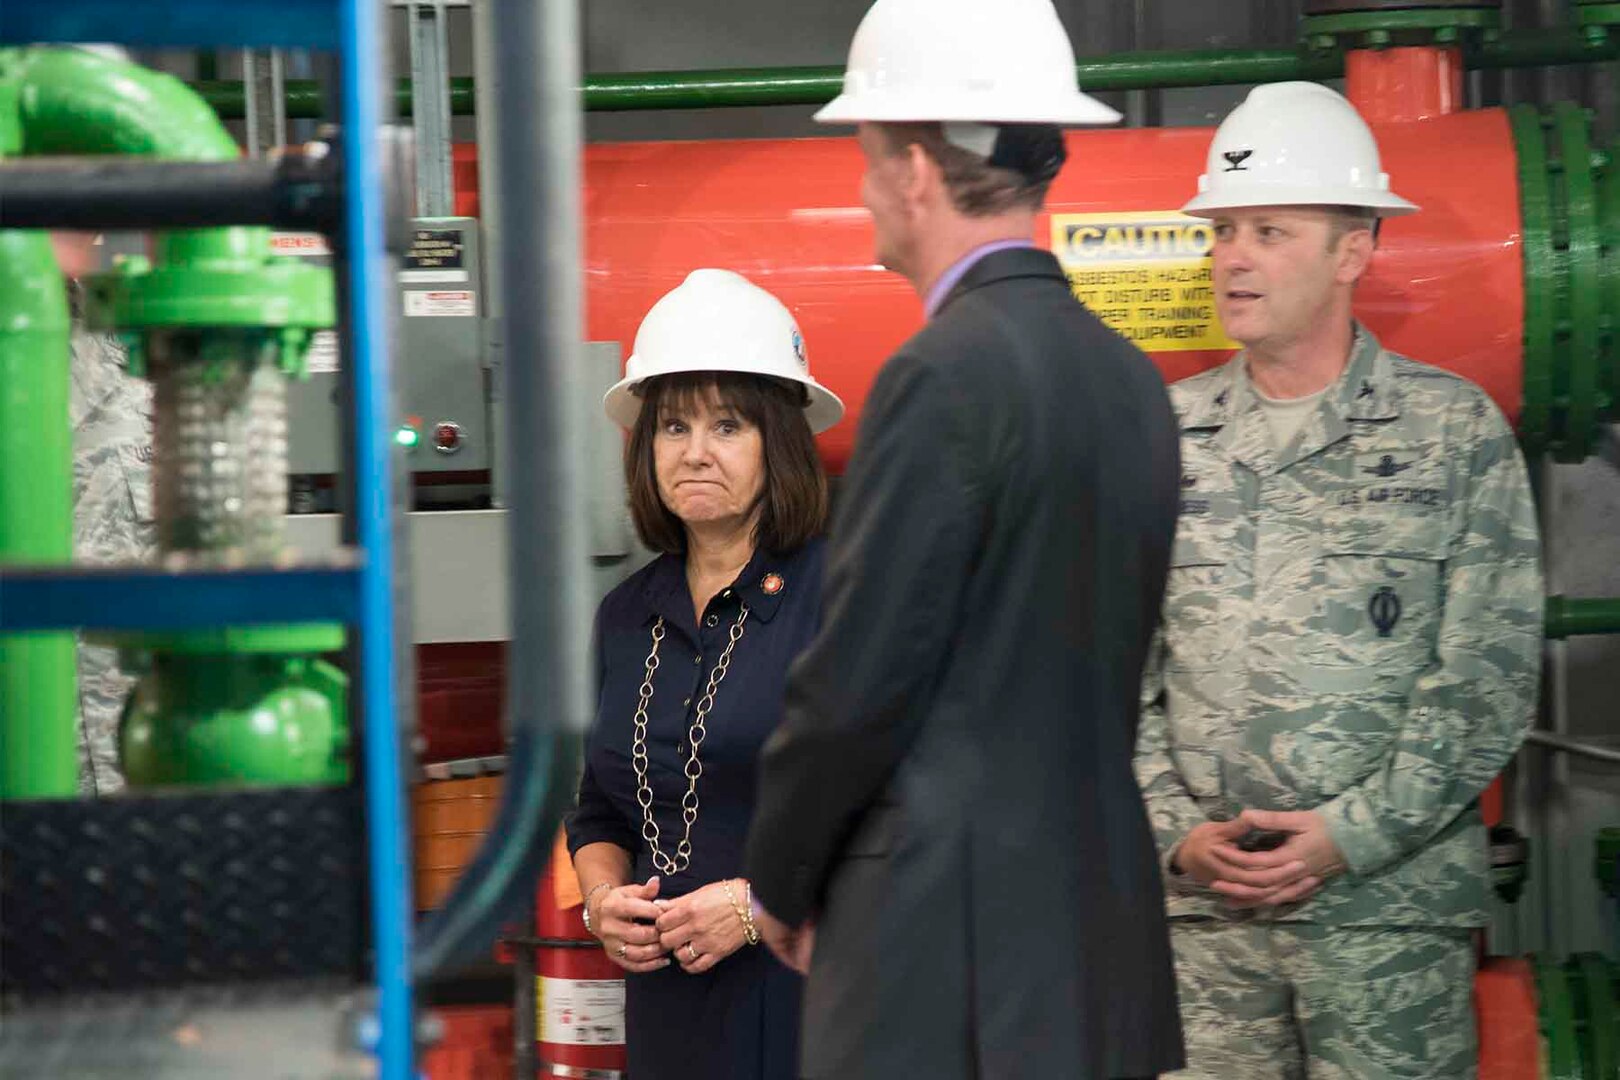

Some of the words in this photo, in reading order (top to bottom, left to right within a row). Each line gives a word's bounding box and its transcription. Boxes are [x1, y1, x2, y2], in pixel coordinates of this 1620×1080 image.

[1070, 224, 1214, 256] CAUTIO
[1075, 270, 1149, 285] SBESTOS
[1158, 268, 1213, 283] HAZAR
[1104, 288, 1172, 303] DISTURB
[1138, 306, 1212, 321] TRAINING
